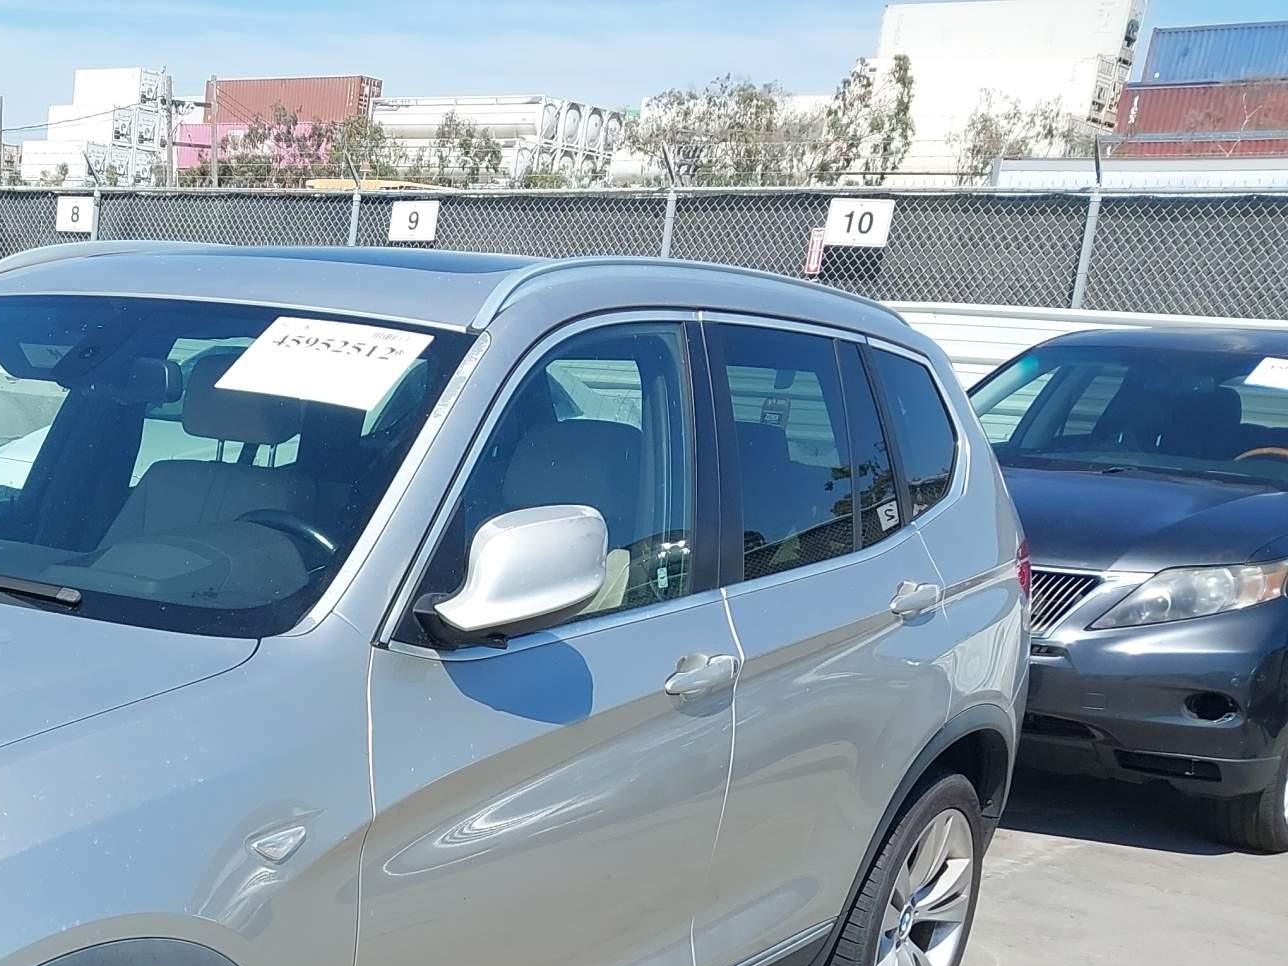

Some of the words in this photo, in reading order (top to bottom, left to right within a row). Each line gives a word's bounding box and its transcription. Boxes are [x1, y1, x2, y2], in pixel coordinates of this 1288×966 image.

[71, 205, 80, 223] 8
[408, 211, 419, 230] 9
[844, 210, 874, 234] 10
[272, 333, 396, 360] 45952512
